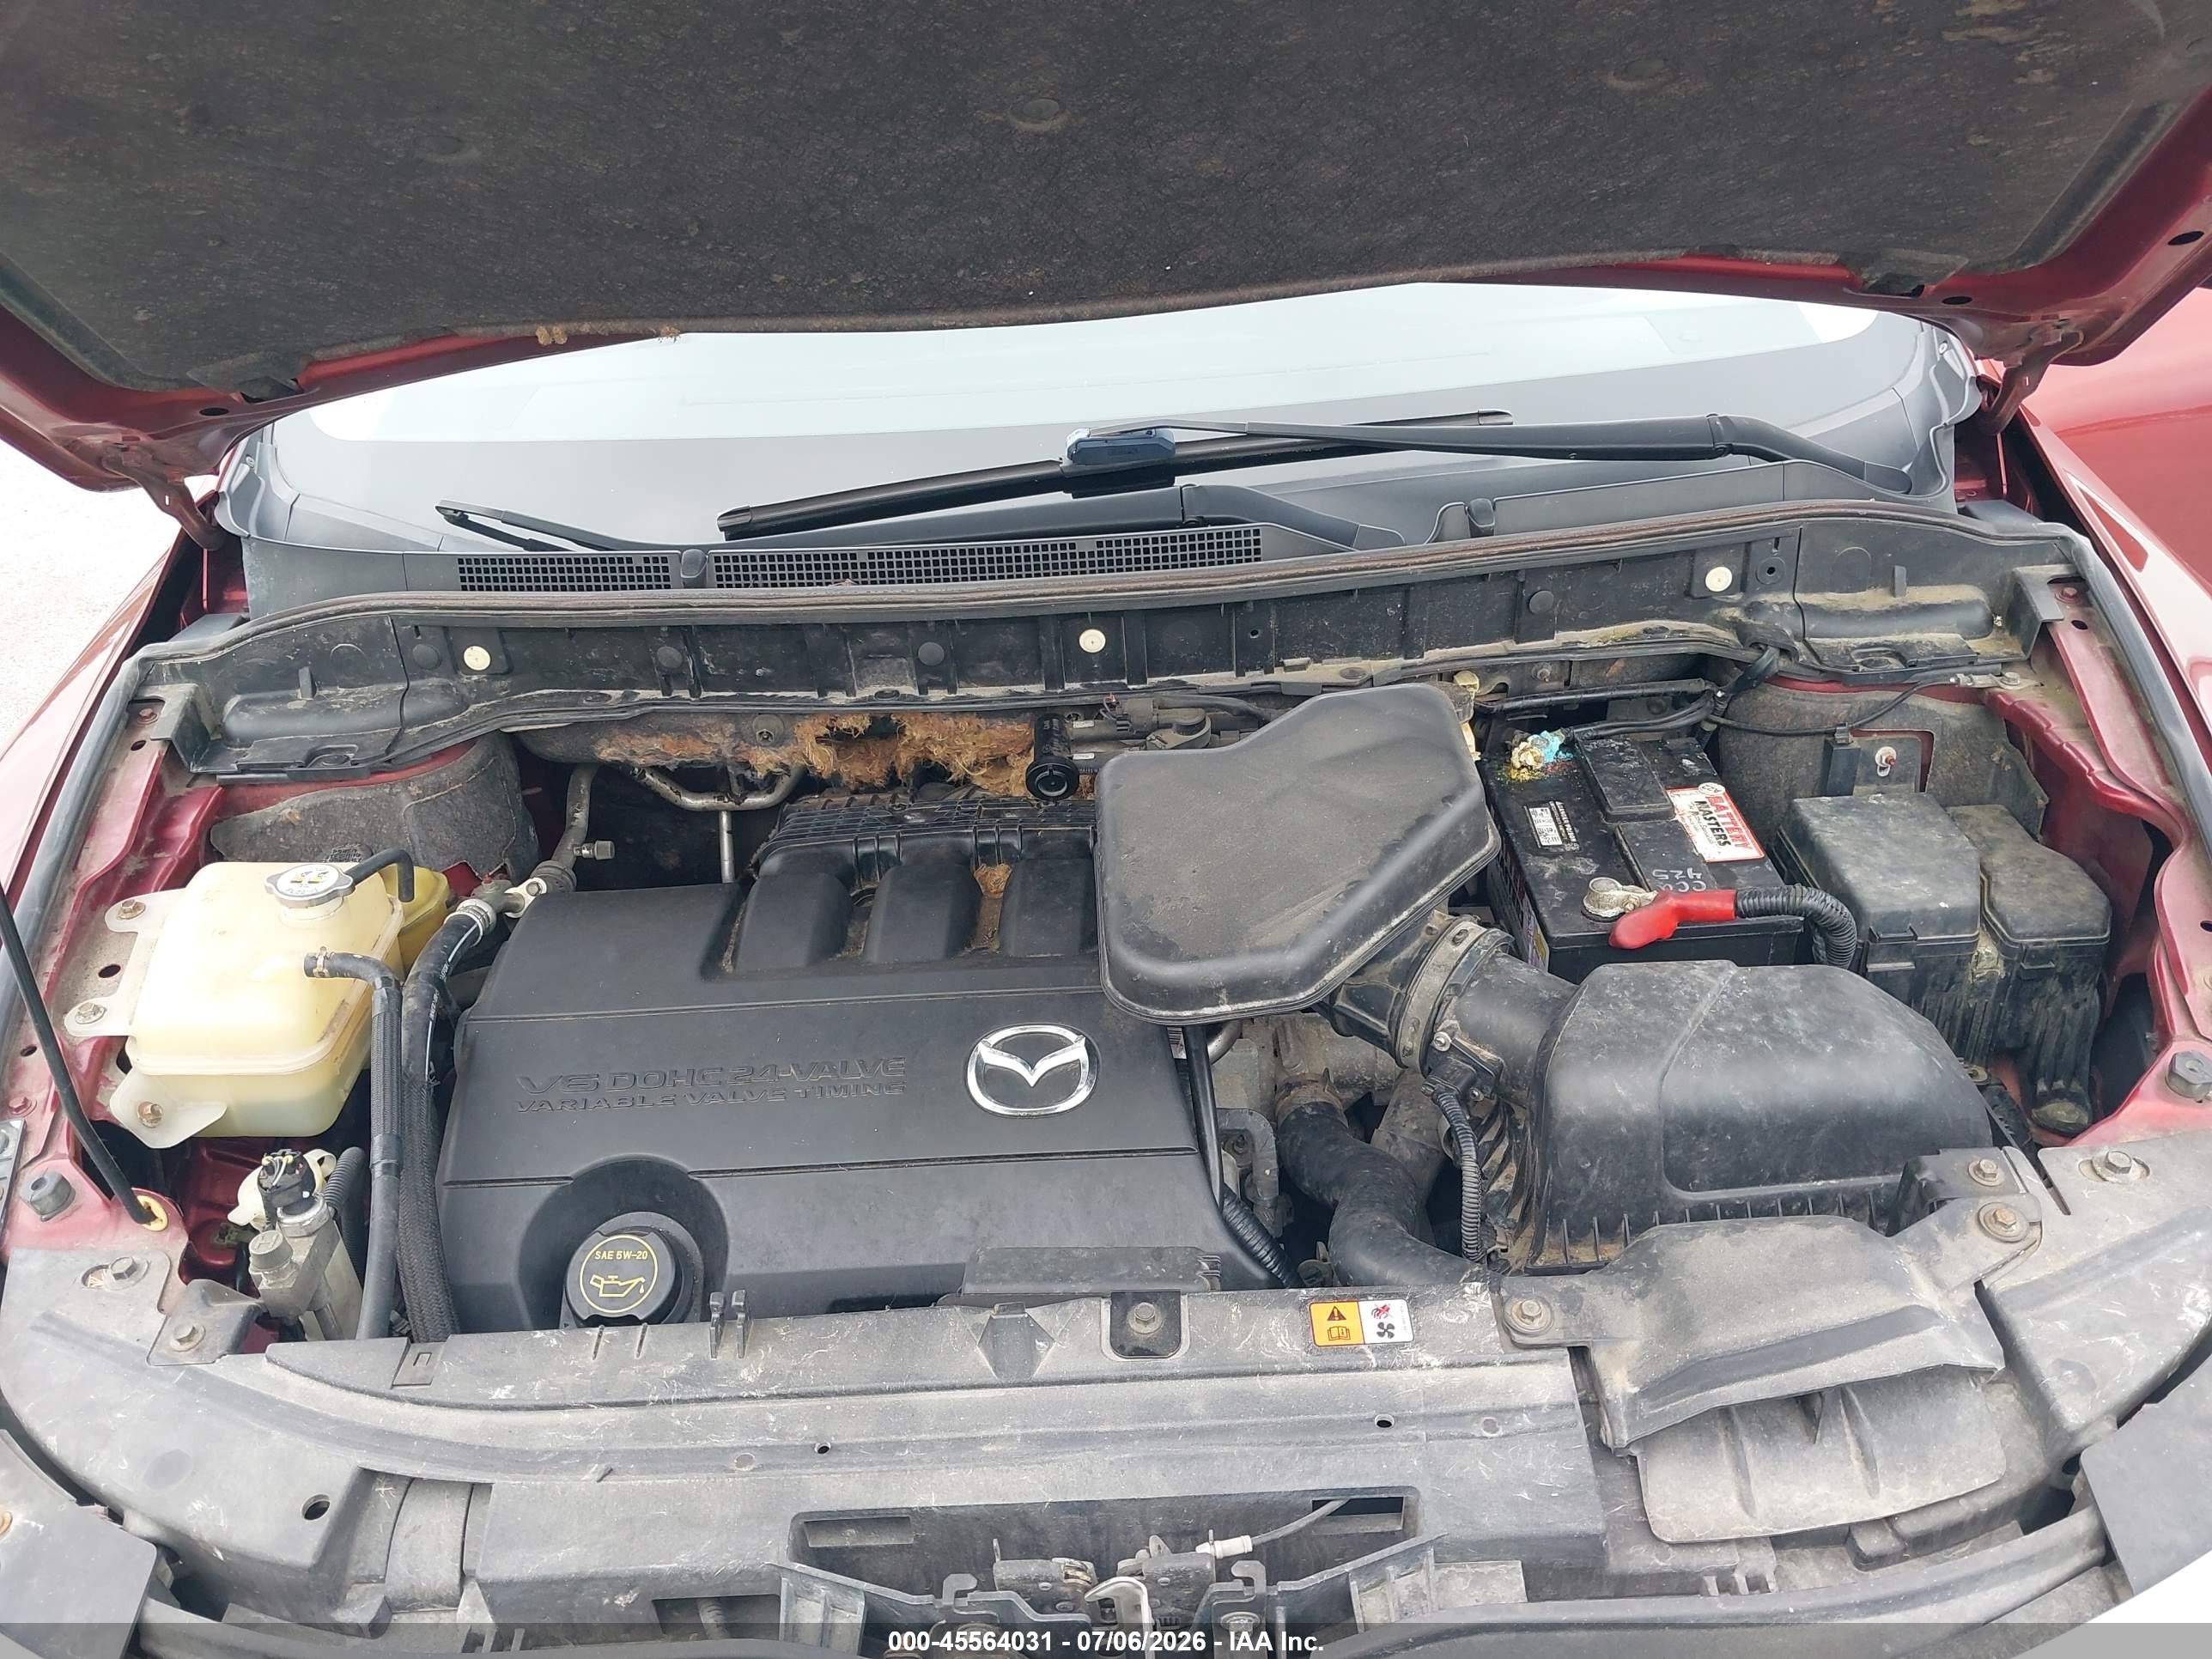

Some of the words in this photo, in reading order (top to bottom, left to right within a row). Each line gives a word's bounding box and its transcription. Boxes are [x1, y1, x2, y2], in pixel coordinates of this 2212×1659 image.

[1694, 800, 1732, 847] MASTERS
[1705, 796, 1753, 850] BATTERY
[1652, 867, 1702, 880] 425
[516, 1073, 600, 1095] V6
[605, 1067, 723, 1091] DOHC
[727, 1056, 907, 1085] 24-VALVE
[516, 1094, 677, 1113] VARIABLE
[686, 1087, 787, 1105] VALVE
[793, 1080, 907, 1099] TIMING
[594, 1250, 614, 1260] SAE
[616, 1250, 648, 1260] 5W-20
